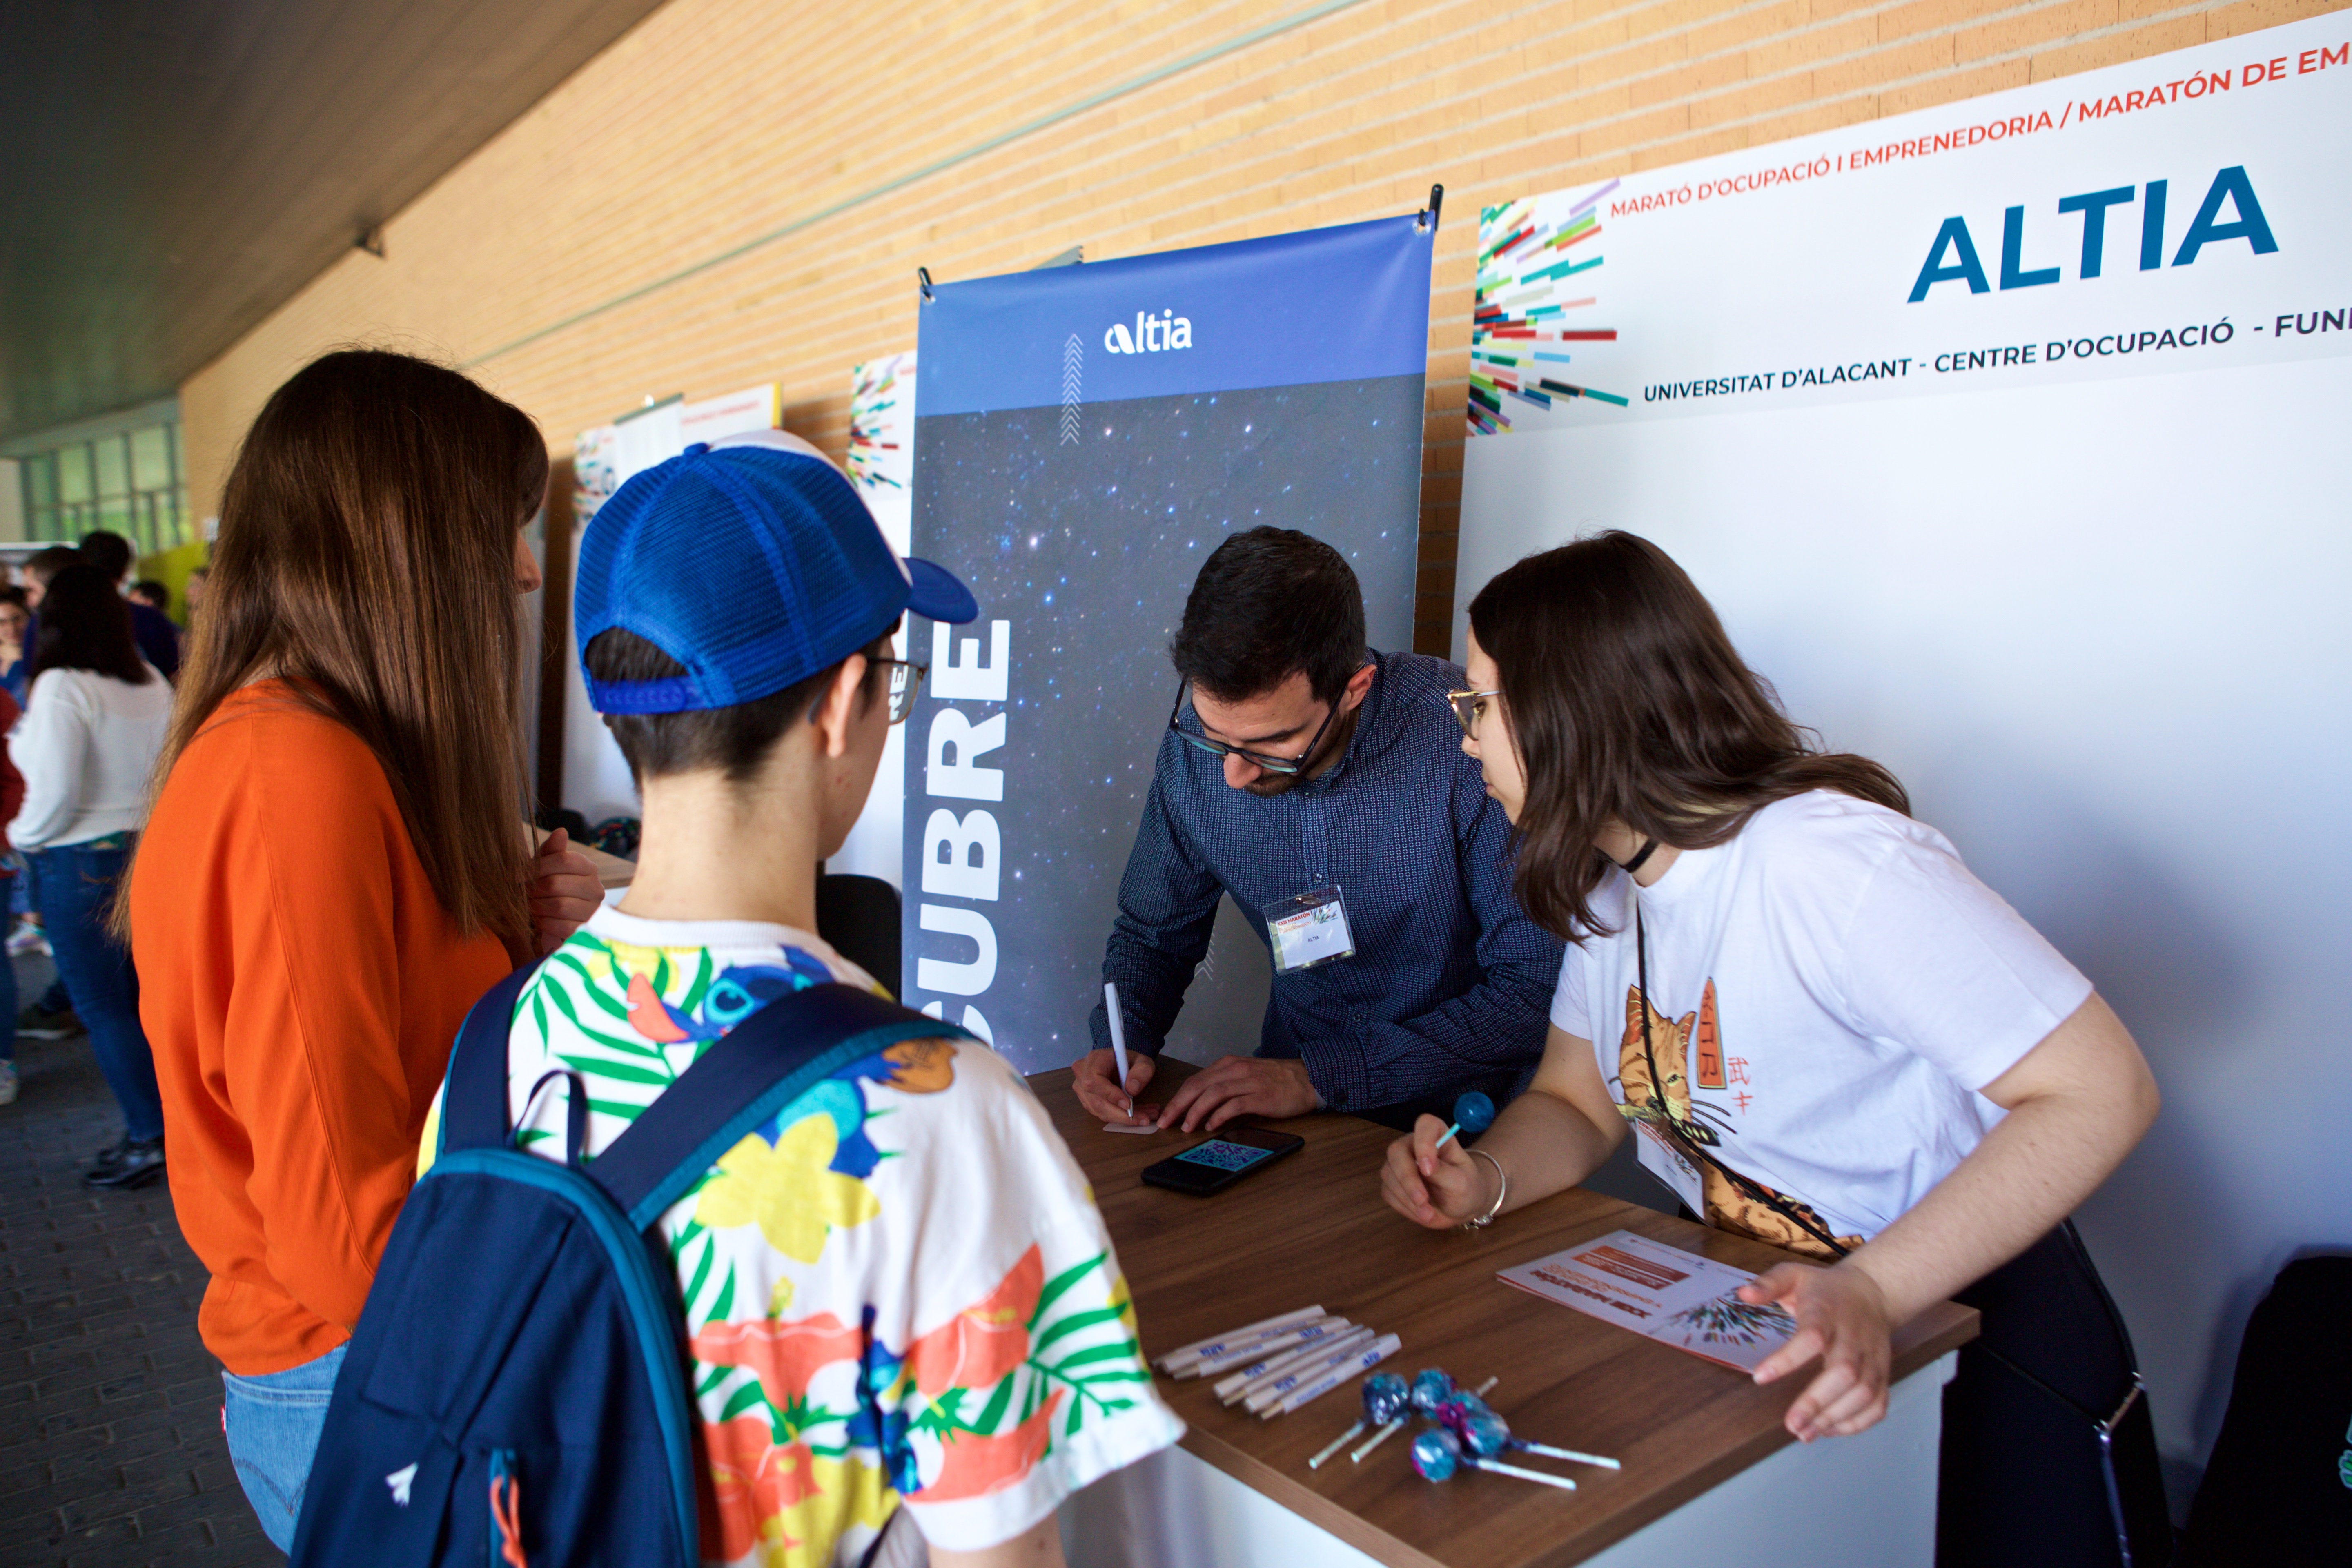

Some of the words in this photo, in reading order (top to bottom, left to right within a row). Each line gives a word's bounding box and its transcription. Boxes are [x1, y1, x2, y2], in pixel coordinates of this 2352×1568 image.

[1611, 185, 1692, 217] MARATÓ
[1698, 155, 1830, 200] D'OCUPACIÓ
[1837, 155, 1842, 172] I
[1849, 111, 2053, 170] EMPRENEDORIA
[2059, 101, 2073, 129] /
[2078, 70, 2232, 122] MARATÓN
[2242, 56, 2287, 87] DE
[2298, 42, 2350, 75] EM
[1907, 165, 2279, 303] ALTIA
[1105, 308, 1192, 354] altia
[1645, 372, 1776, 402] UNIVERSITAT
[1782, 358, 1912, 388] D'ALACANT
[1935, 344, 2037, 372] CENTRE
[2046, 316, 2234, 361] D'OCUPACIÓ
[2275, 307, 2352, 337] FUN
[1287, 911, 1310, 923] MARATÓN
